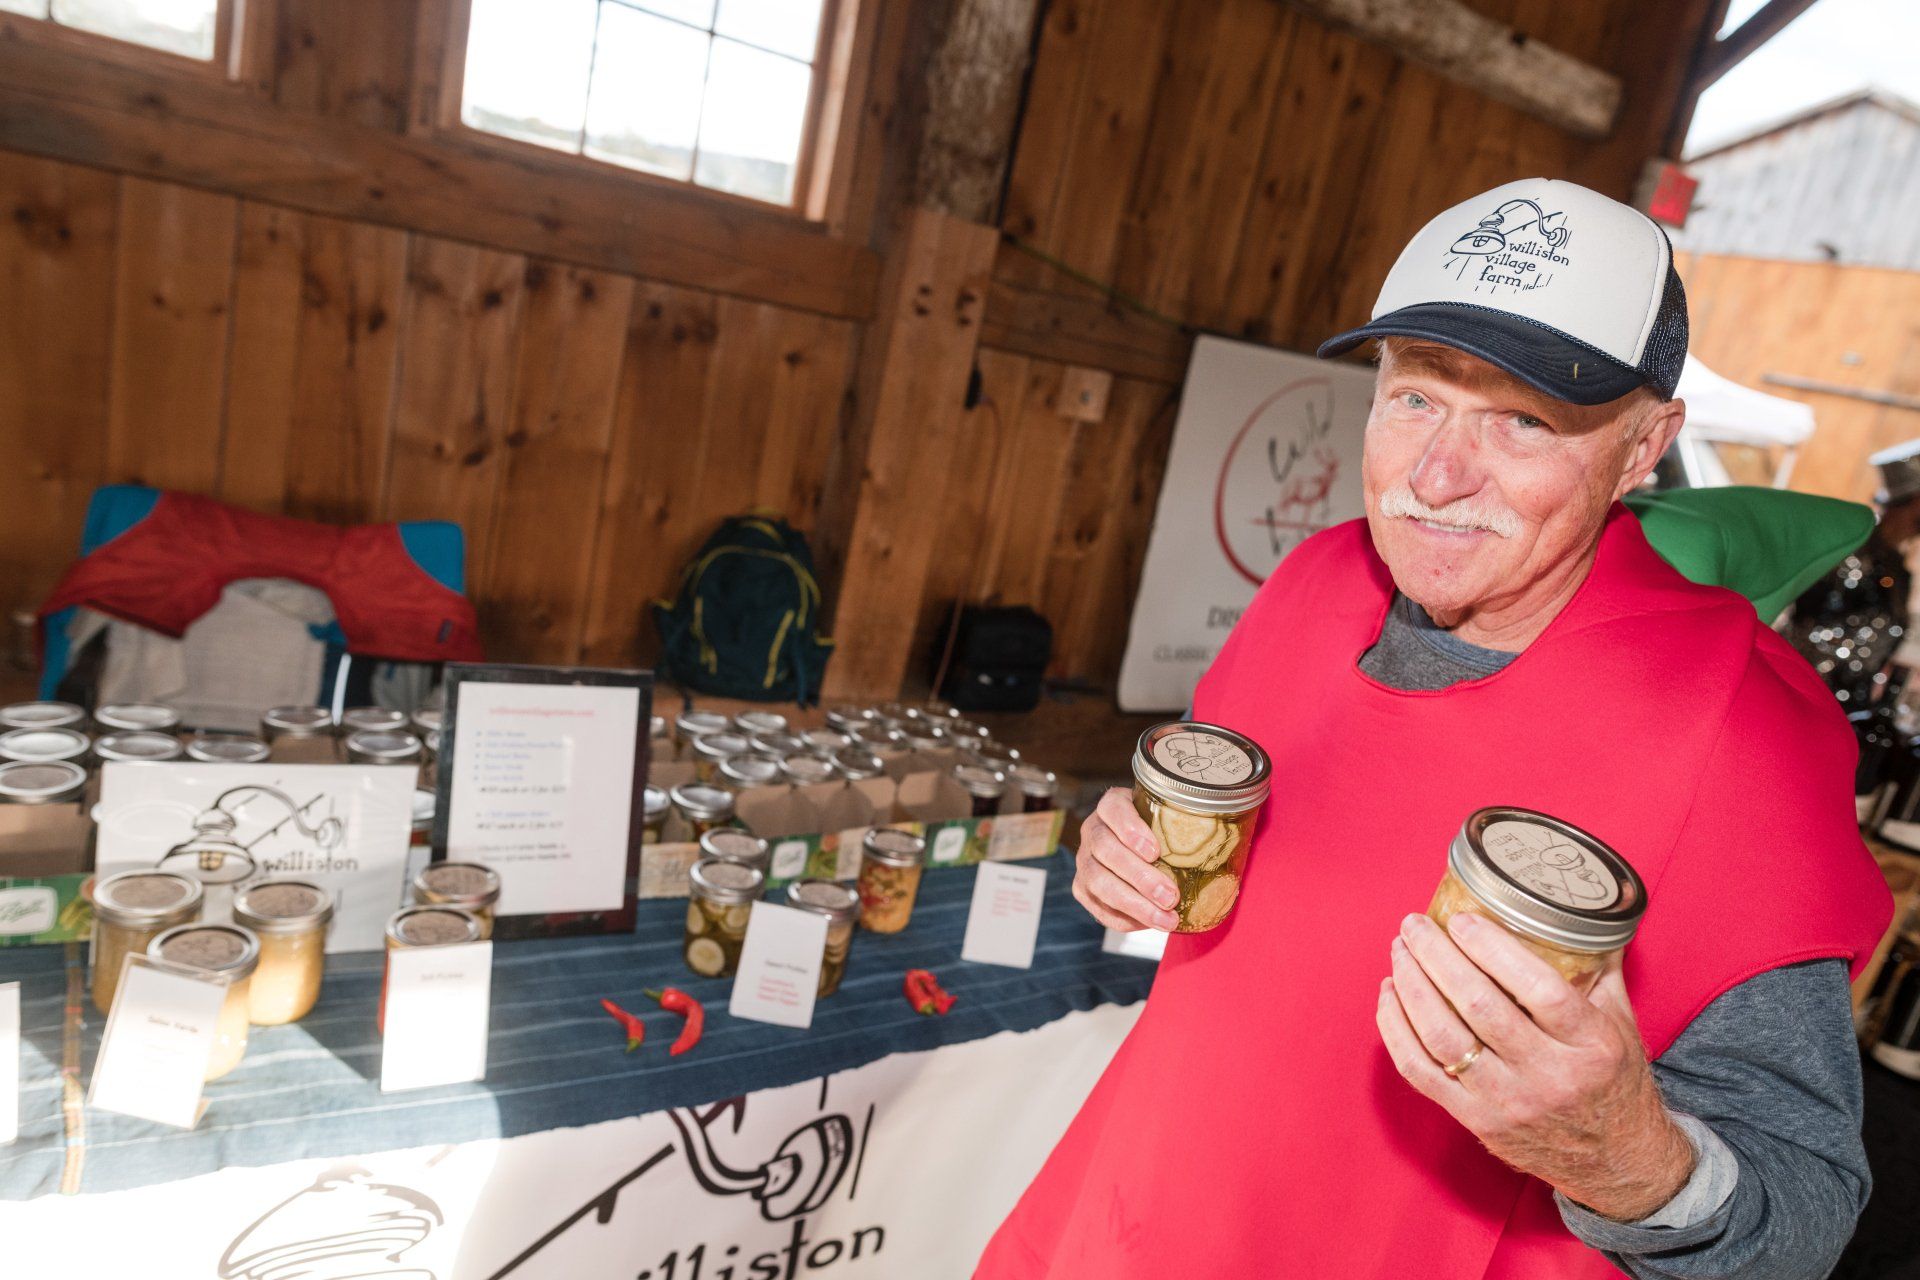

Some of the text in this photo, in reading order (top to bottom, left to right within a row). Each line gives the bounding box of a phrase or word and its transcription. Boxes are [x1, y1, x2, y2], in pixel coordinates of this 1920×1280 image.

[1485, 253, 1536, 274] village
[1509, 241, 1570, 266] williston
[1479, 265, 1522, 287] farm
[262, 848, 359, 874] williston
